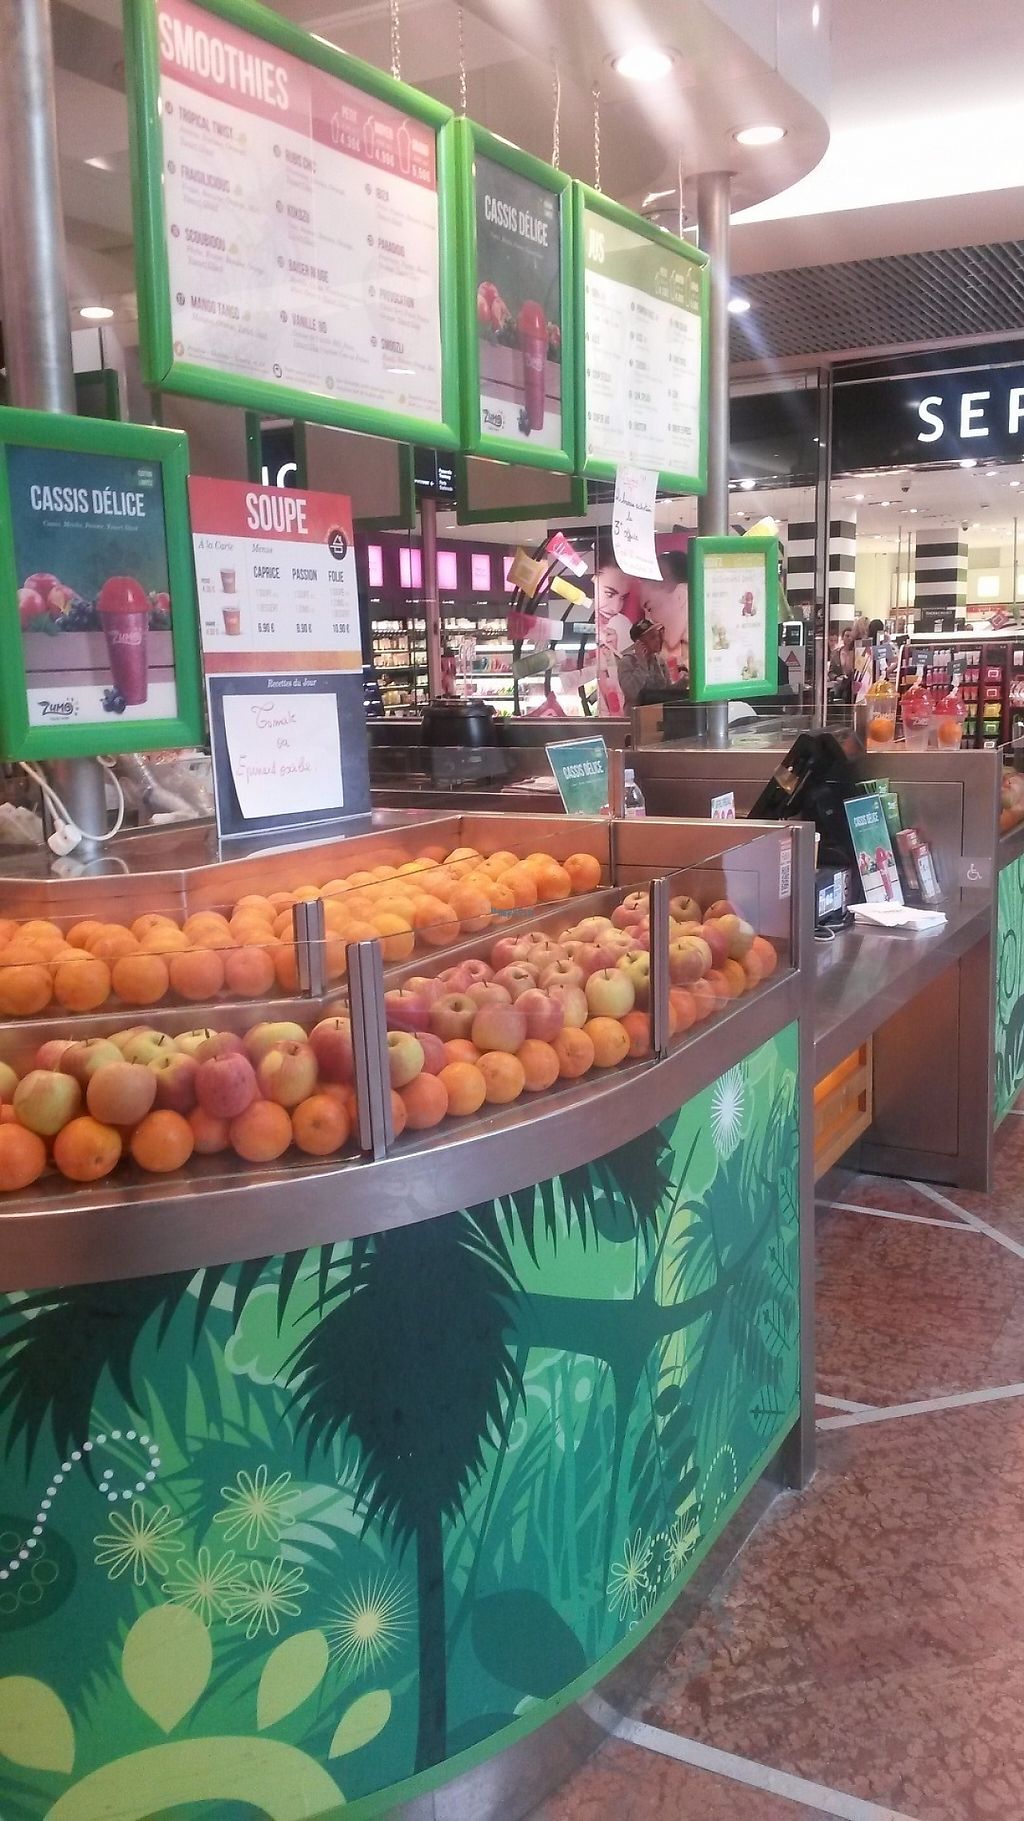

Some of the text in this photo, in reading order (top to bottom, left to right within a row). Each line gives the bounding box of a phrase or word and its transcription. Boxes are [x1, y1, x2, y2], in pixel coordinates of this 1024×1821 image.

[158, 12, 289, 111] SMOOTHIES
[484, 194, 518, 233] CASSIS
[519, 210, 549, 248] DÉLICE
[588, 228, 605, 264] JUS
[30, 485, 146, 517] CASSIS DÉLICE
[246, 491, 309, 534] SOUPE
[253, 565, 280, 579] CAPRICE
[291, 568, 318, 582] PASSION
[328, 570, 344, 583] FOLIE
[267, 677, 317, 689] Recettes du Jour
[37, 700, 75, 716] ZUMO
[562, 764, 585, 780] CASSIS
